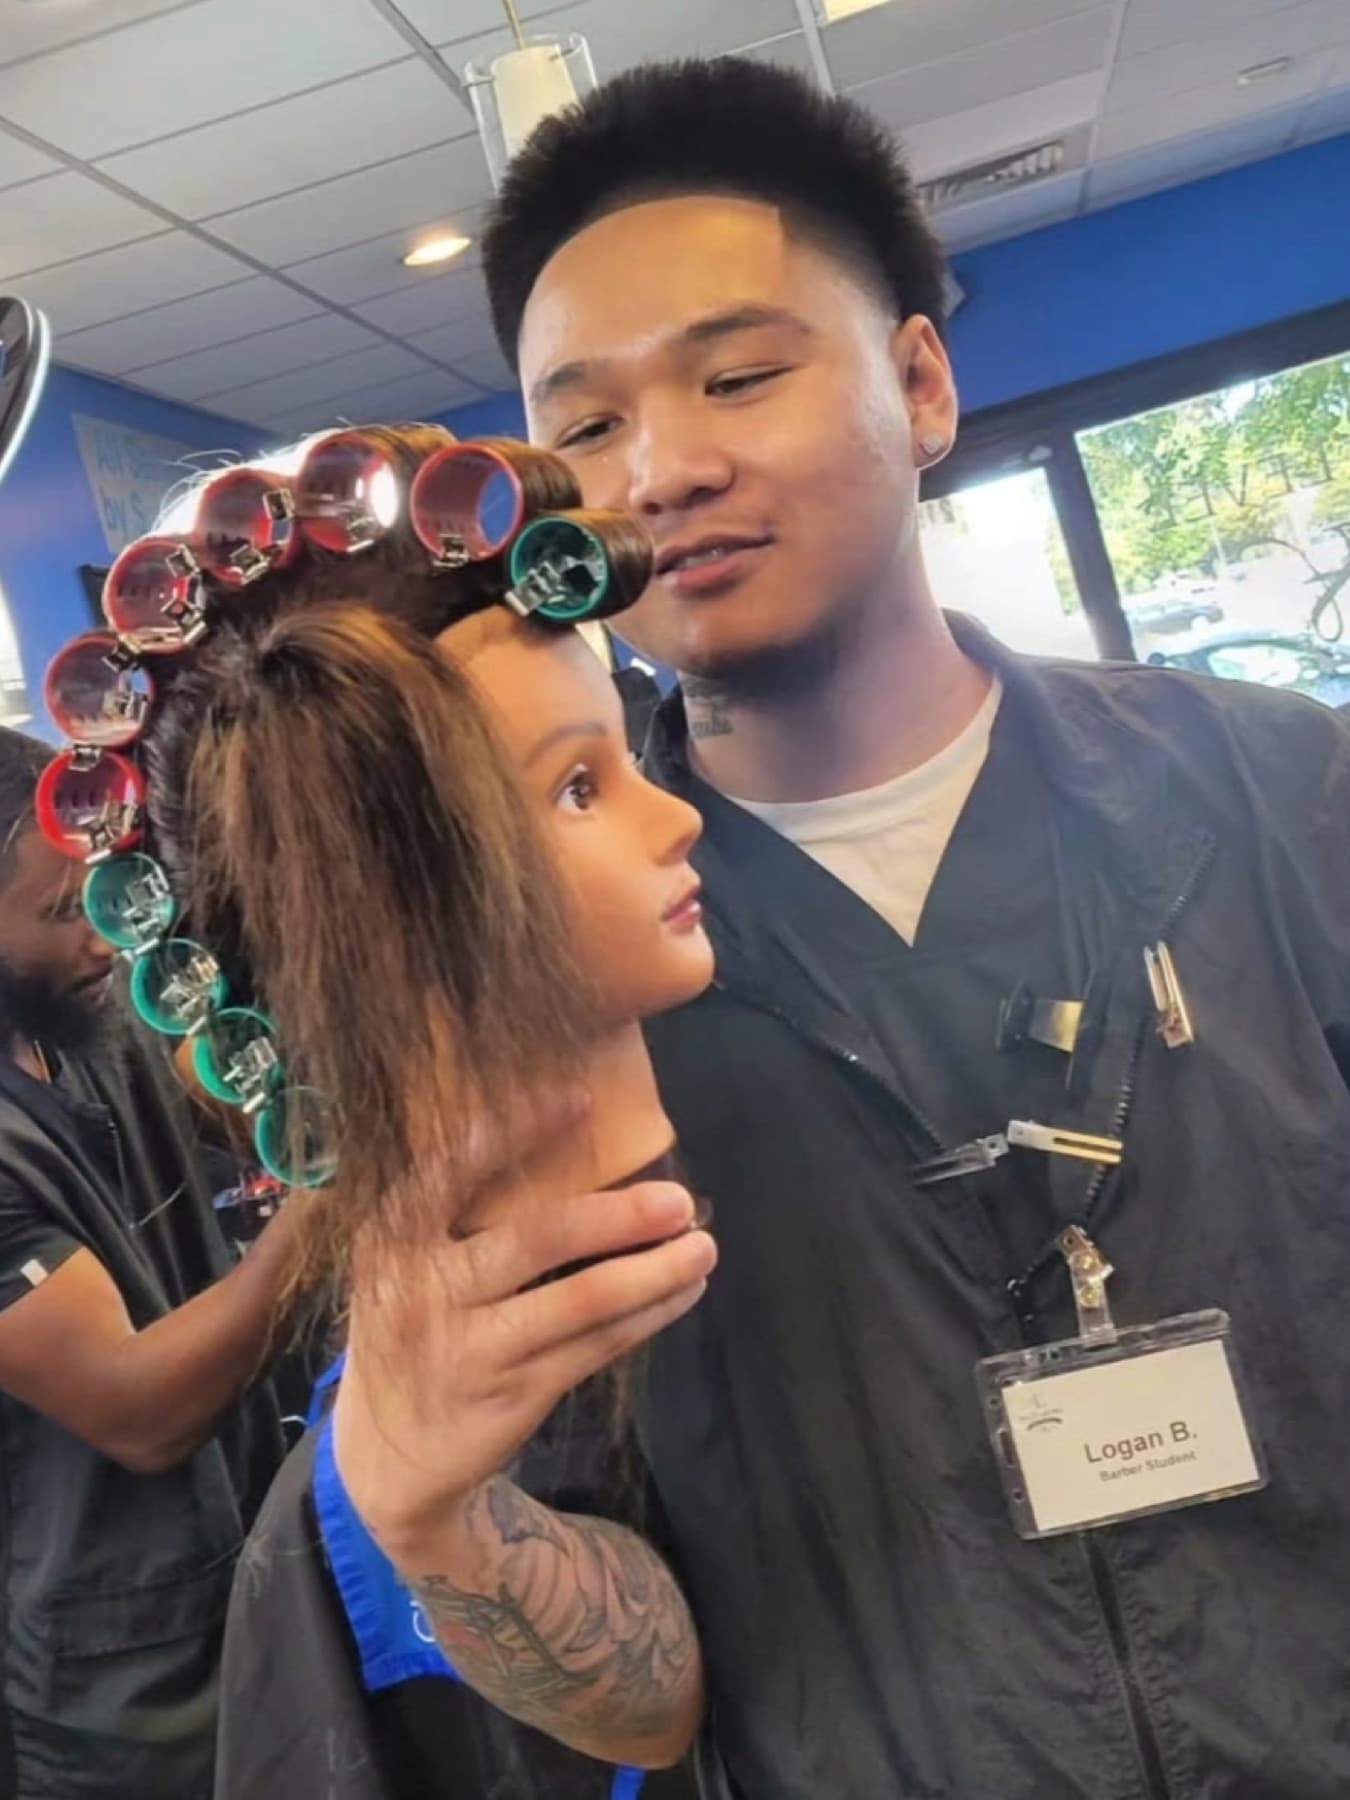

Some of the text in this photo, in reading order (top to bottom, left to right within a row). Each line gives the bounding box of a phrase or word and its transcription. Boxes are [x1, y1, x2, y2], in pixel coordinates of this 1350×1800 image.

[1083, 1421, 1199, 1464] Logan B.
[1099, 1450, 1198, 1482] Barber Student
